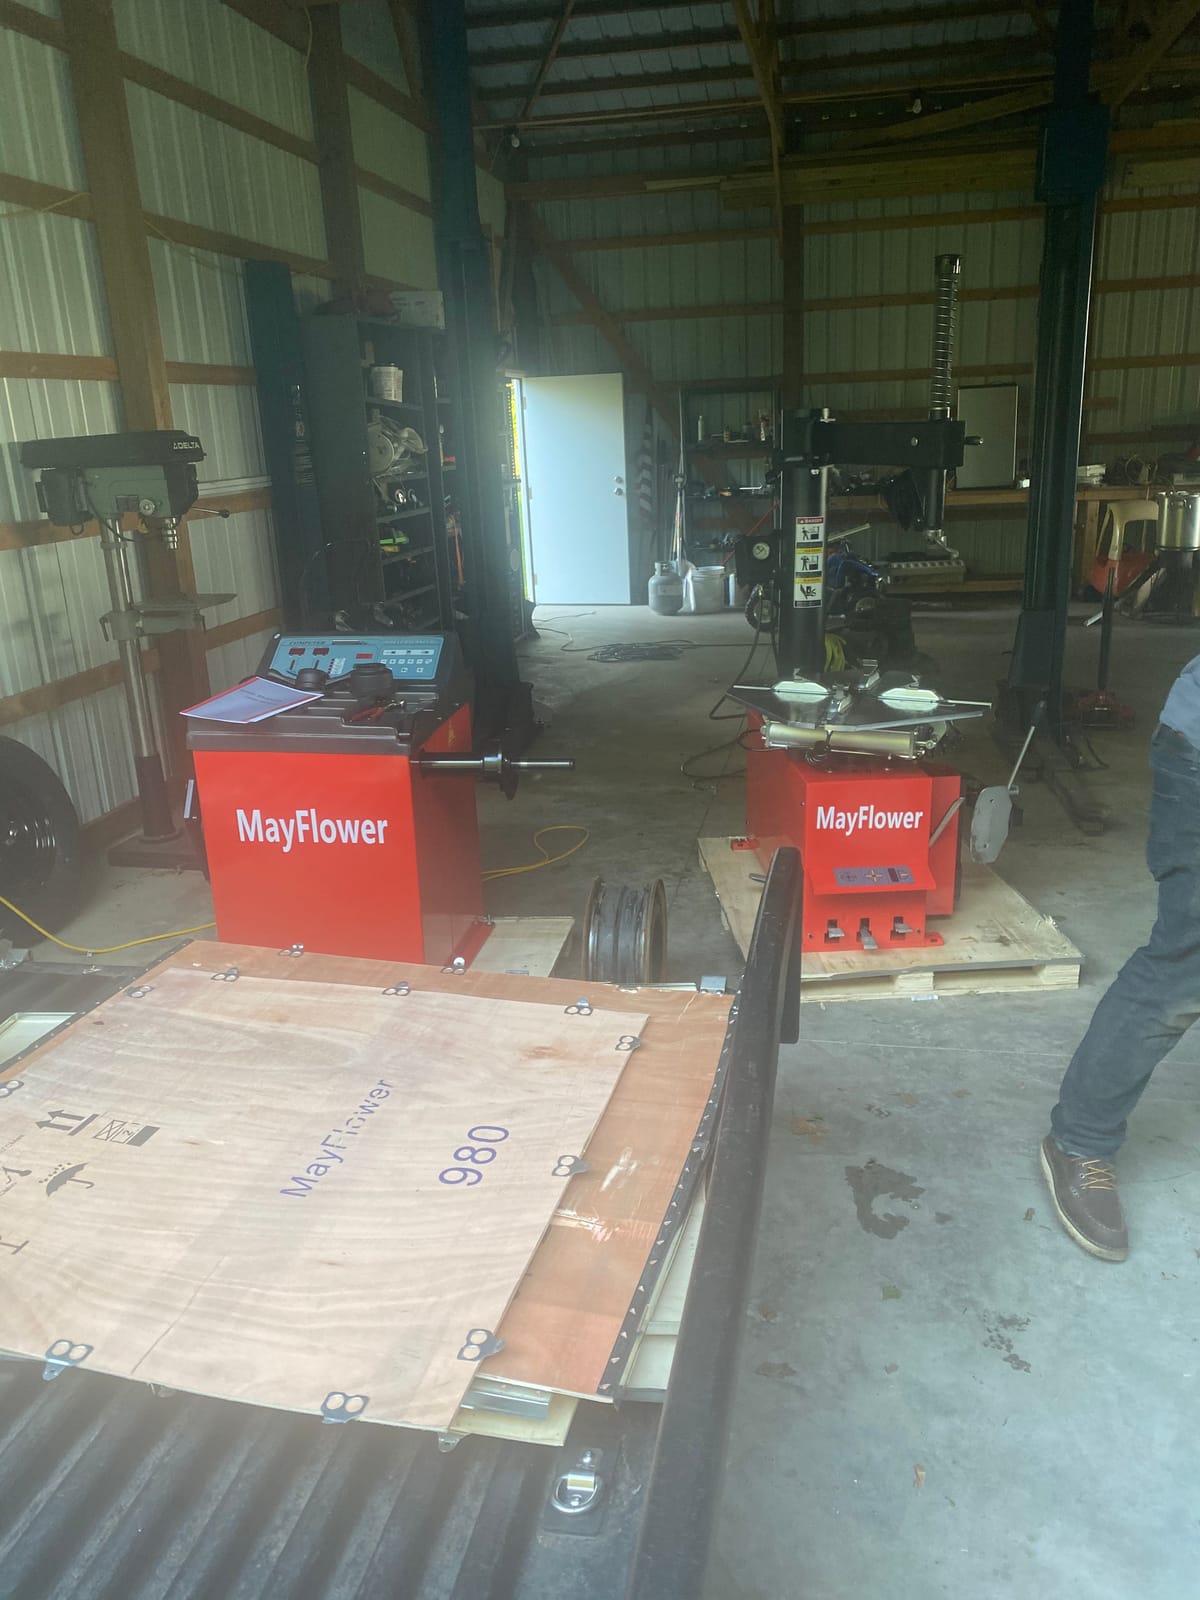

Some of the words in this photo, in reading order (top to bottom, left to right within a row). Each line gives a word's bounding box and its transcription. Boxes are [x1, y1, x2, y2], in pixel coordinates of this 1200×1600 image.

[177, 441, 200, 449] DELTA
[236, 808, 388, 852] MayFlower
[816, 804, 924, 836] MayFlower
[280, 1079, 394, 1197] MayFlower
[438, 1125, 509, 1186] 980
